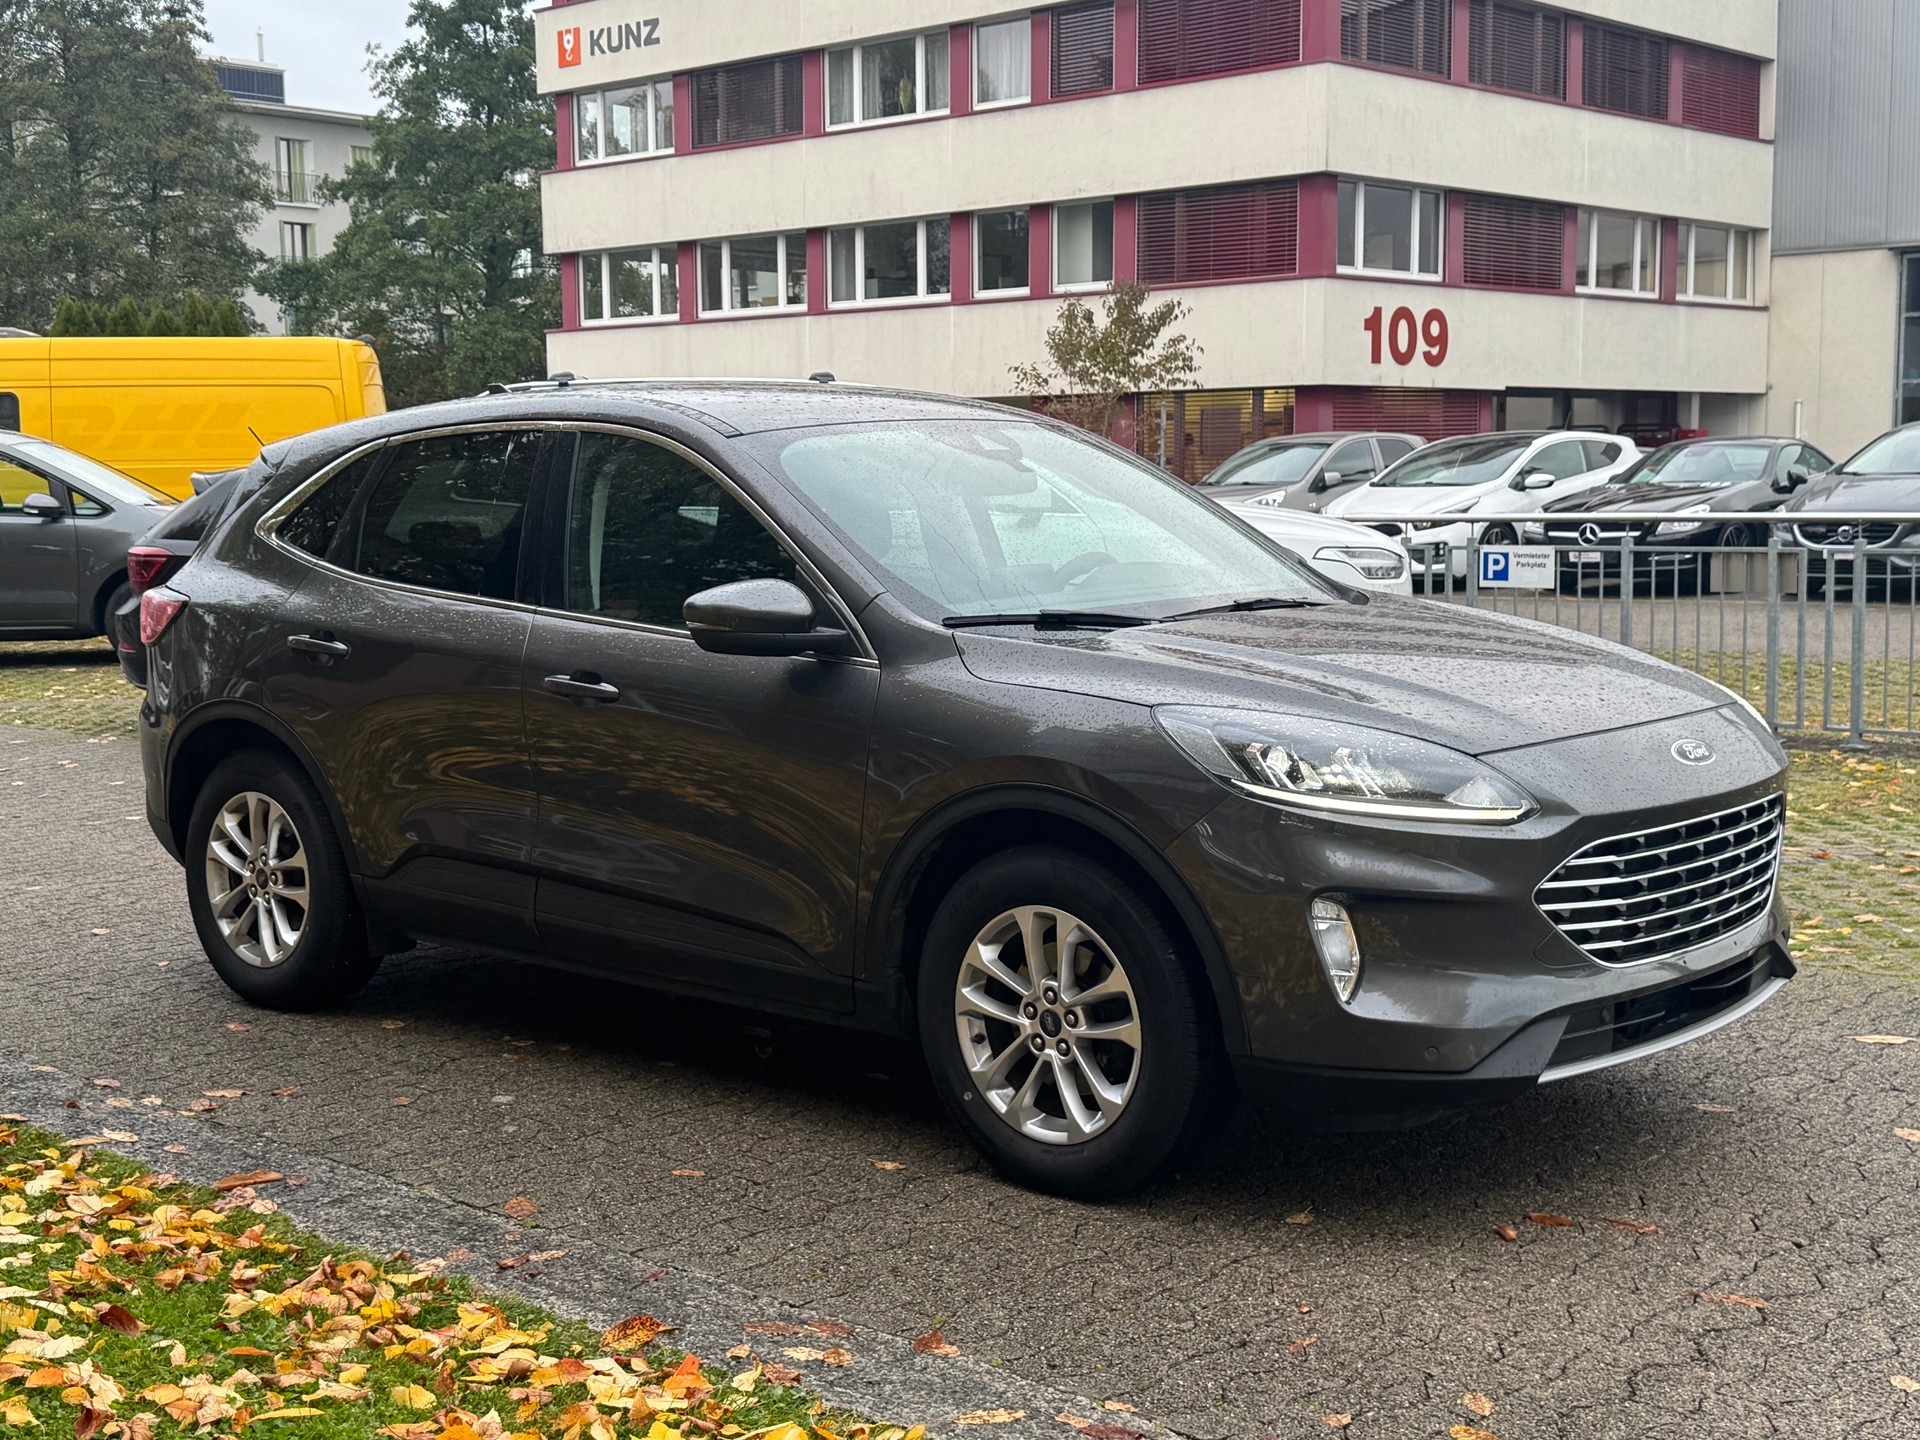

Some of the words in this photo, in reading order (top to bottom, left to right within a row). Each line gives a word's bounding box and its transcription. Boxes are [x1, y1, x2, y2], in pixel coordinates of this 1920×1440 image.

[589, 17, 660, 56] KUNZ
[1363, 305, 1449, 368] 109
[1487, 553, 1506, 579] P
[1515, 560, 1547, 570] Parkplatz
[1682, 743, 1709, 759] Ford
